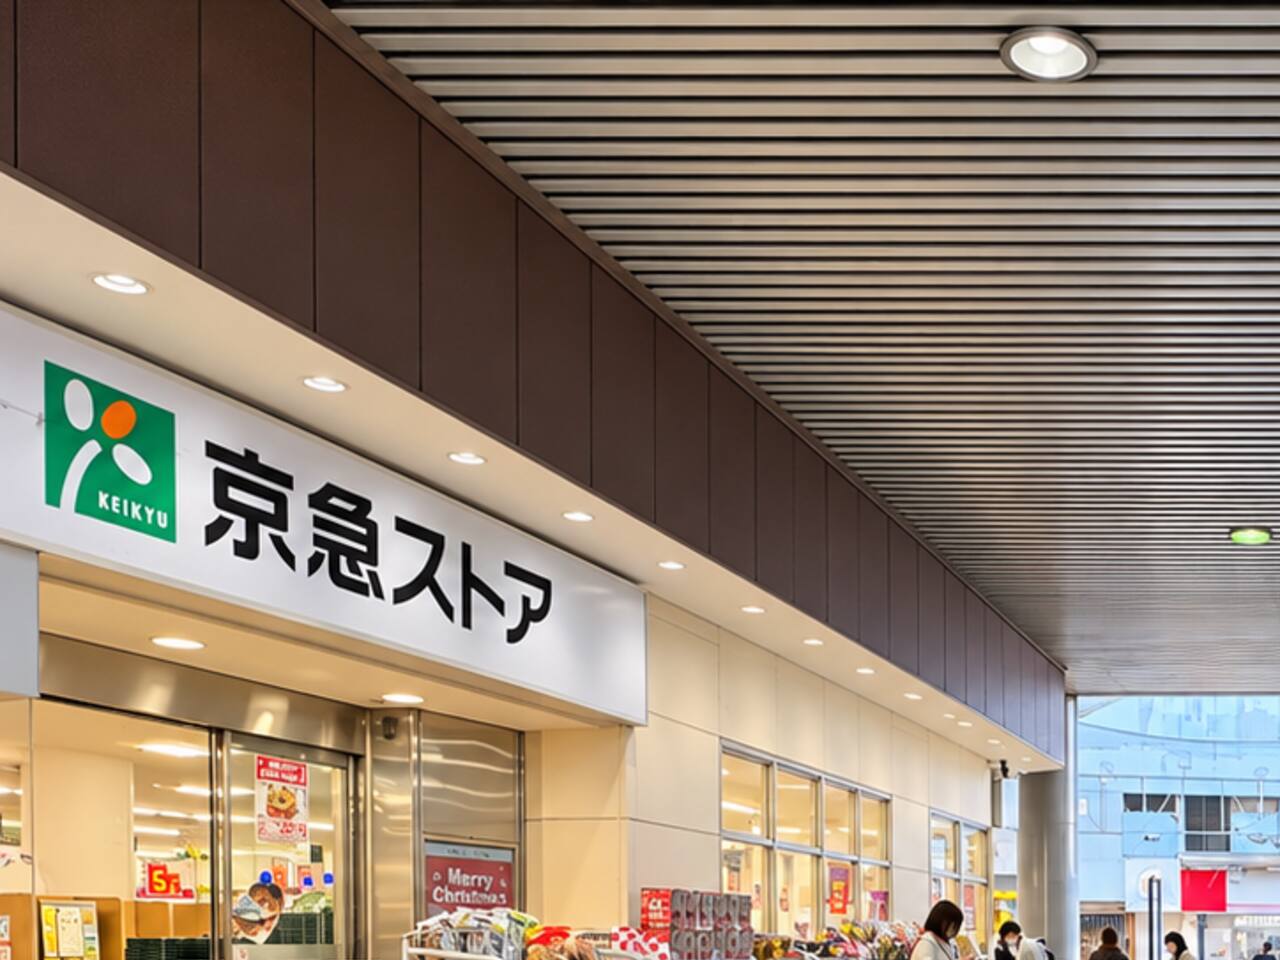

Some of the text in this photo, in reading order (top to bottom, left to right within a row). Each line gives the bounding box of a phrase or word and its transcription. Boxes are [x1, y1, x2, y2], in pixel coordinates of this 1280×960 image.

[98, 490, 169, 530] KEIKYU
[204, 439, 552, 644] 京急ストア
[432, 886, 507, 904] Christmas
[448, 867, 494, 891] Merry
